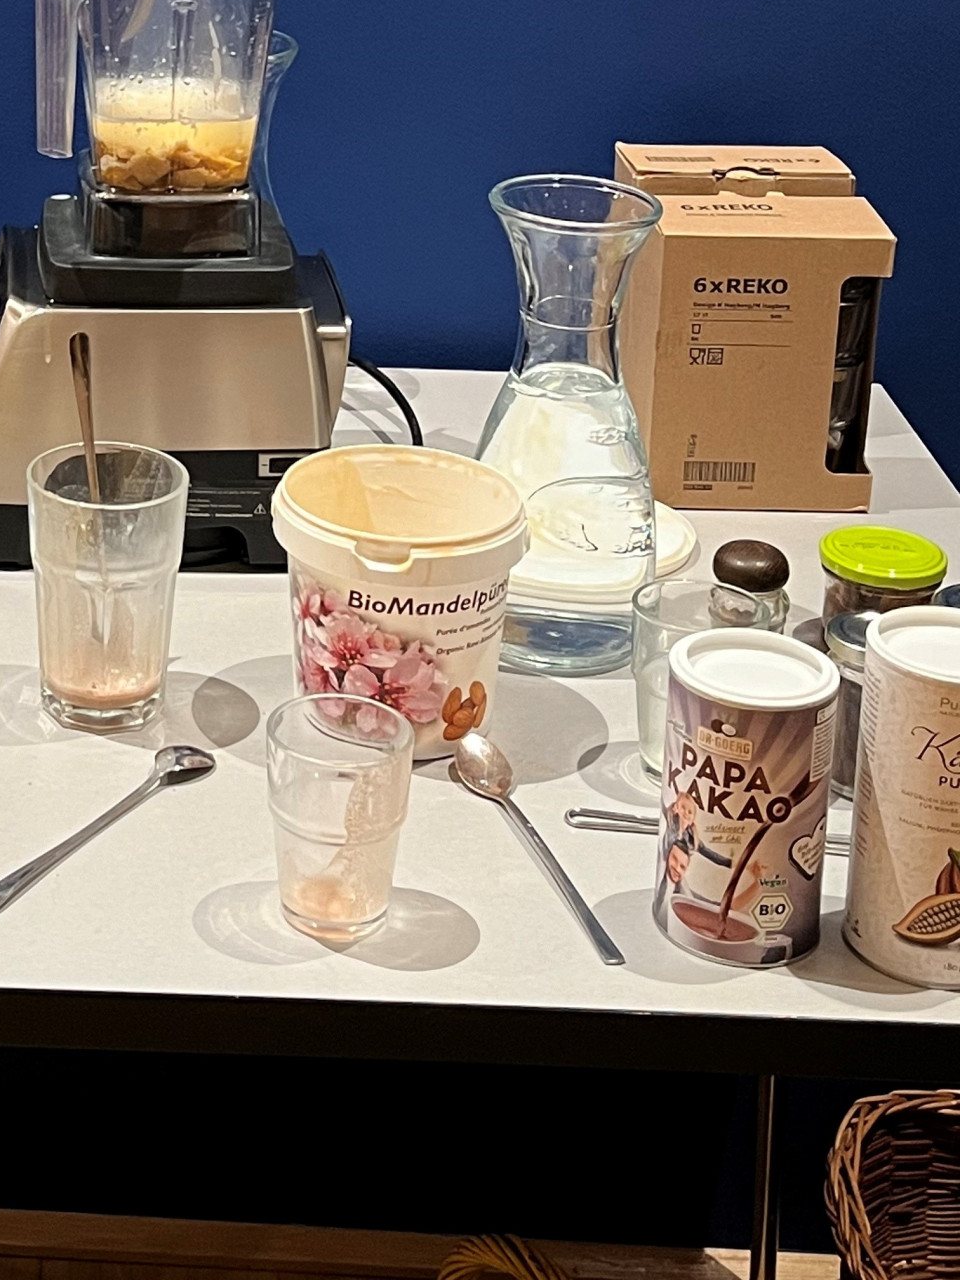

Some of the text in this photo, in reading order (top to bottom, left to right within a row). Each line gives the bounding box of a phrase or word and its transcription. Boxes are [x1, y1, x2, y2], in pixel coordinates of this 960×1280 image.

[680, 203, 773, 211] 6xREKO
[693, 277, 789, 294] 6xREKO
[681, 742, 772, 795] PAPA
[668, 760, 792, 823] KAKAO
[760, 877, 787, 888] Vegan
